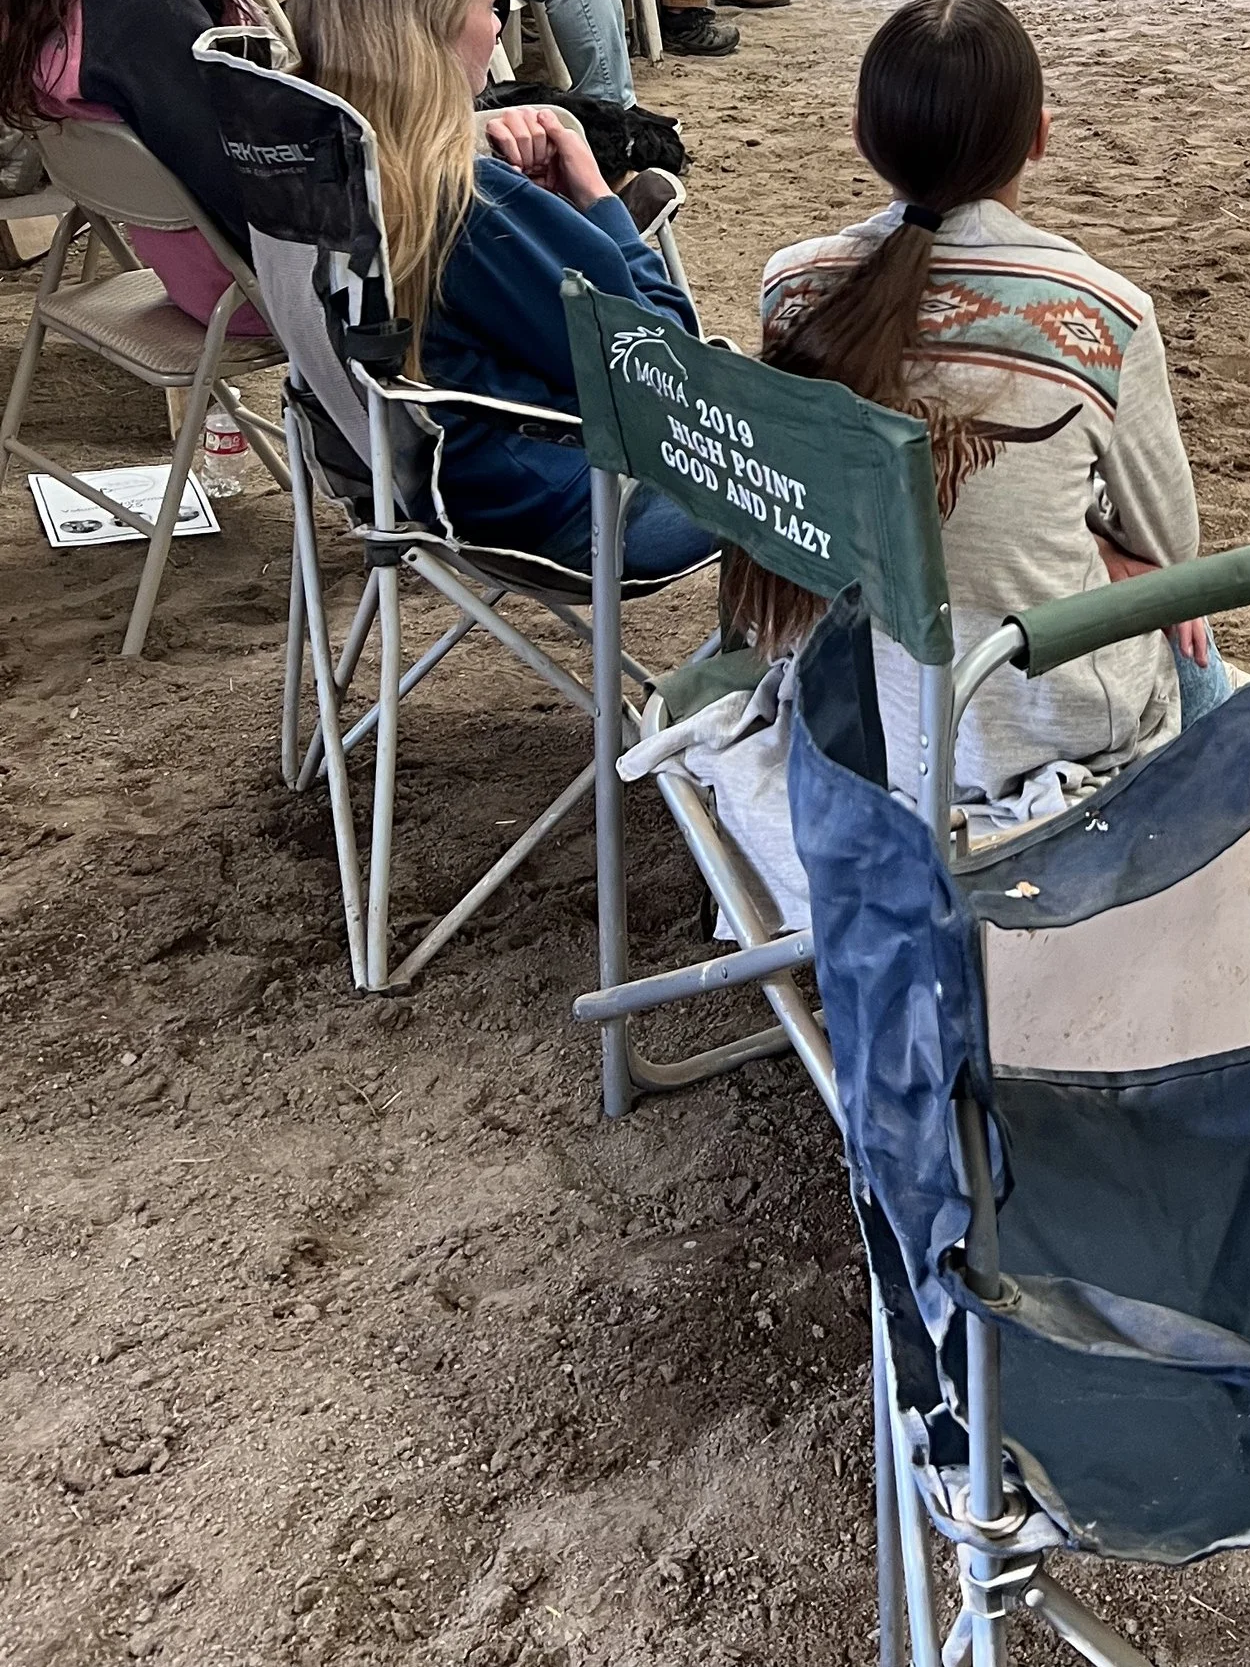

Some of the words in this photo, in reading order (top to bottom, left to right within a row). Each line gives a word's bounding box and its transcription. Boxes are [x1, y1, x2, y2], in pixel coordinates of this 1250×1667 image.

[666, 414, 728, 469] HIGH
[730, 448, 807, 510] POINT
[695, 398, 754, 449] 2019
[660, 440, 719, 492] GOOD
[726, 477, 768, 522] AND
[773, 504, 832, 560] LAZY
